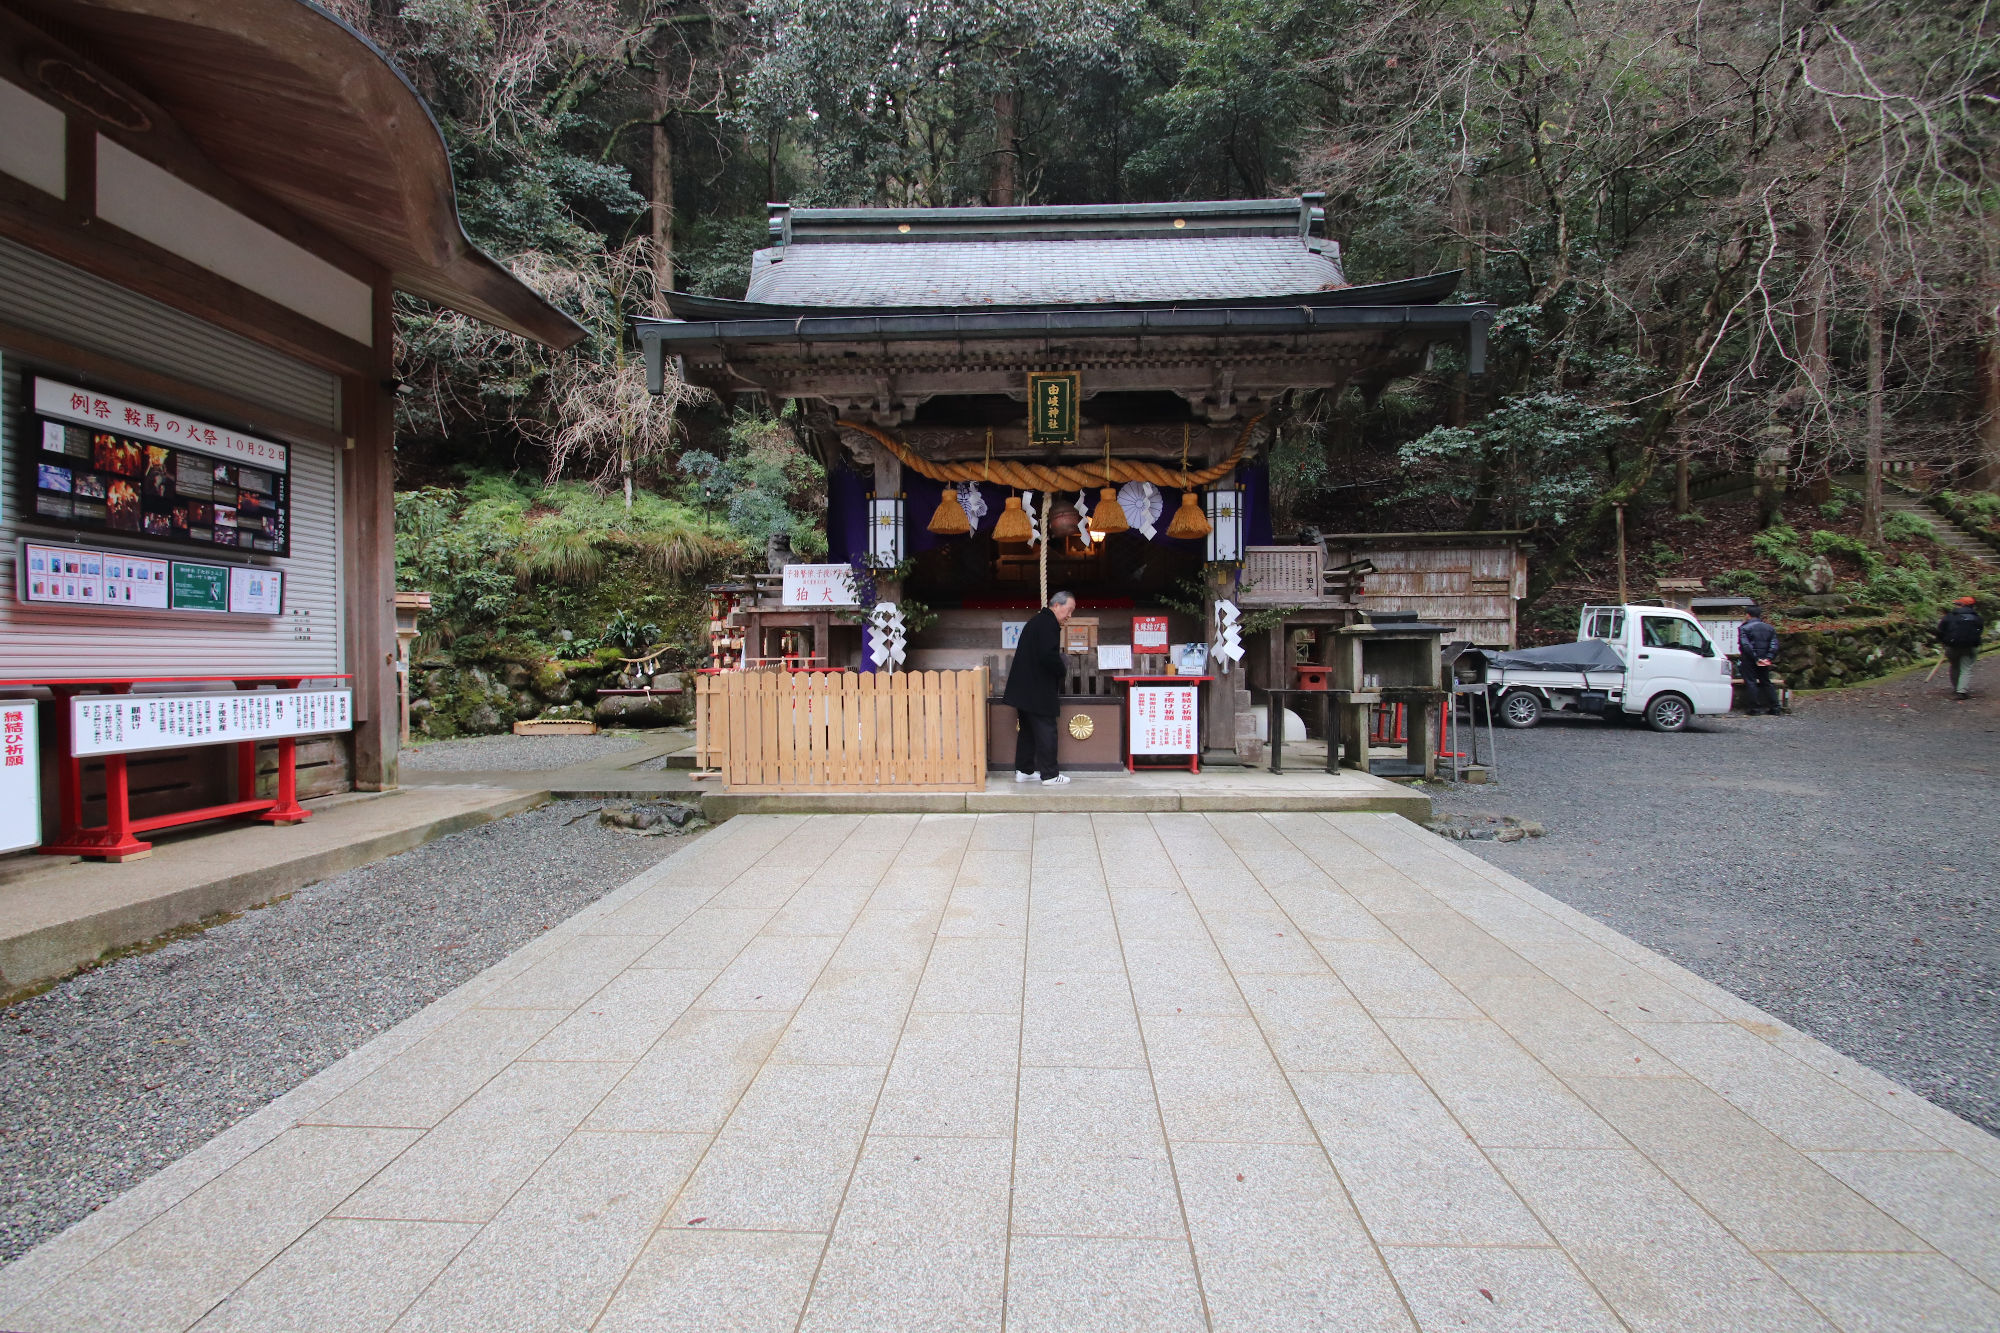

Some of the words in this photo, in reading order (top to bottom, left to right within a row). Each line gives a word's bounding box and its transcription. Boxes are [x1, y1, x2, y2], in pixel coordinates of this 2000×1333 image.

[70, 392, 112, 420] 例祭
[124, 406, 218, 446] 鞍馬の火祭
[1047, 383, 1060, 429] 由岐神社
[131, 706, 141, 730] 願掛け
[1164, 691, 1175, 721] 子授け祈願
[1181, 691, 1192, 721] 縁結び祈願
[4, 711, 24, 767] 縁結び祈願
